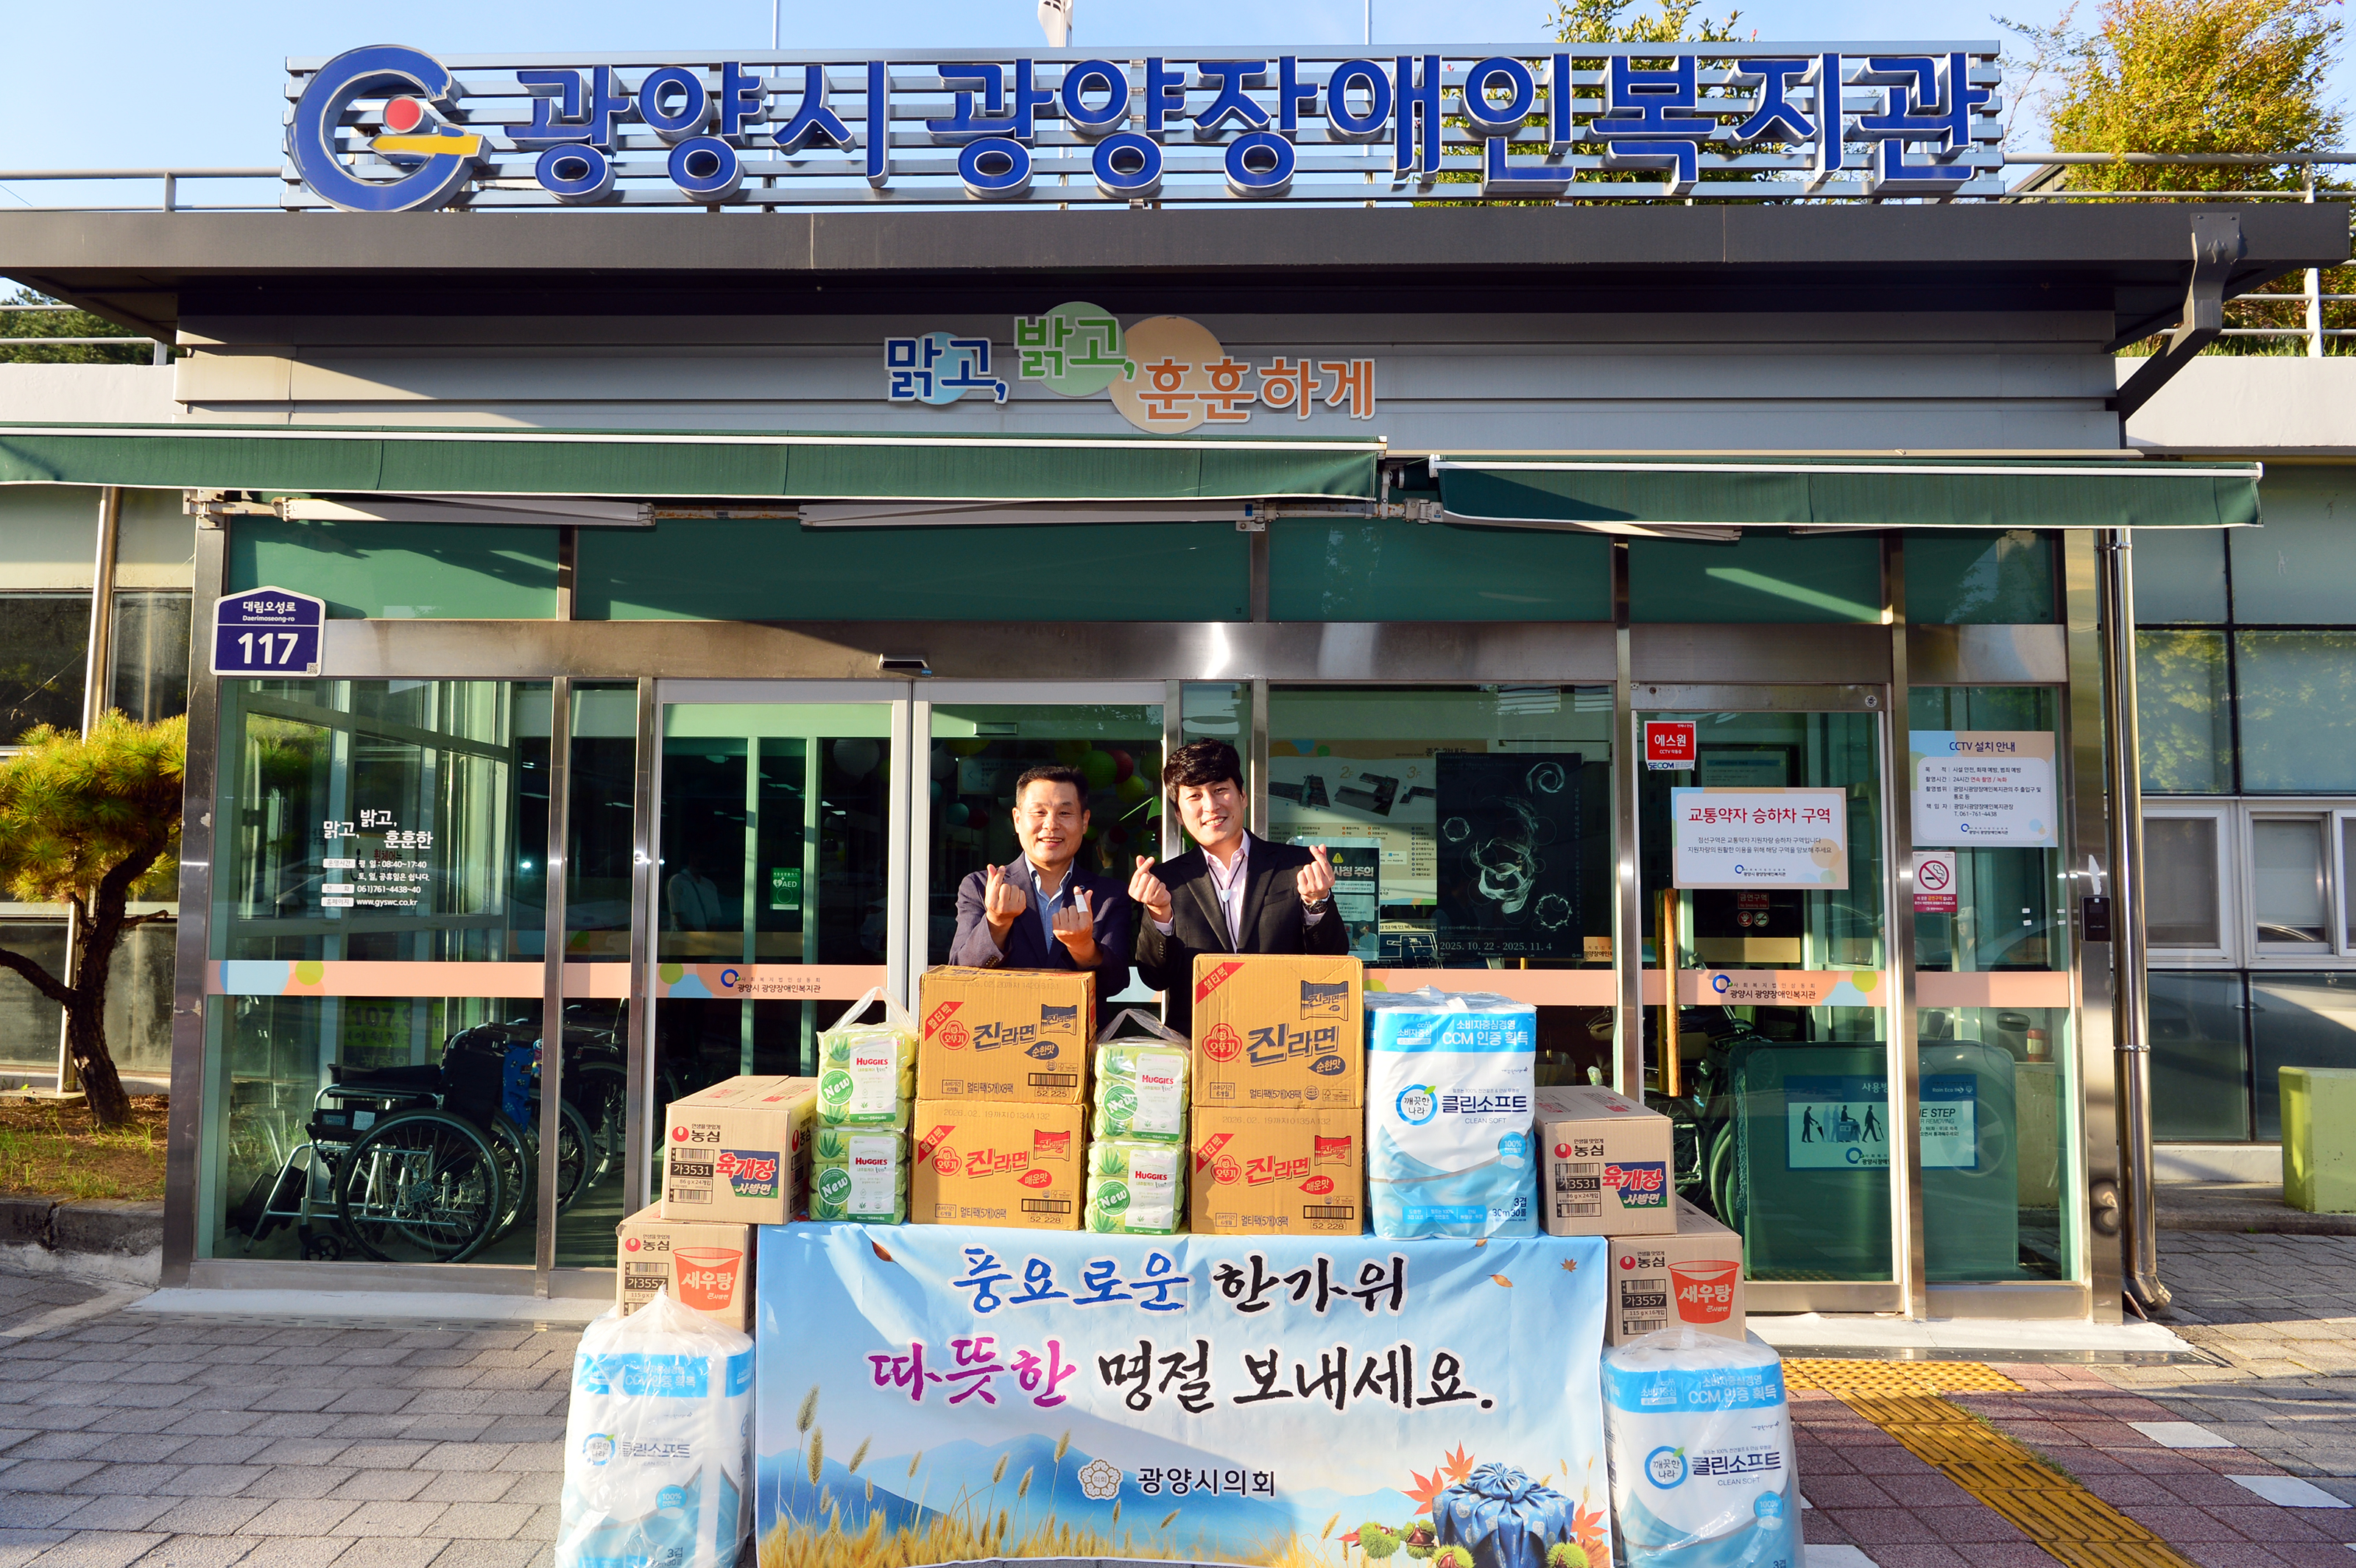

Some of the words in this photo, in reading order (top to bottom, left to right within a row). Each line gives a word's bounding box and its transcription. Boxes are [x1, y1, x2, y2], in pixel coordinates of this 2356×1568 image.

[504, 60, 890, 202] 광양시
[925, 52, 1992, 199] 광양장애인복지관
[1014, 314, 1137, 382] 밝고,
[885, 336, 1011, 404] 맑고,
[1137, 356, 1375, 423] 훈훈하게
[243, 601, 296, 614] 대림오성로
[238, 633, 298, 664] 117
[1654, 734, 1686, 746] 에스원
[1949, 741, 1972, 751] CCTV
[1975, 741, 1994, 752] 설치
[1997, 741, 2015, 752] 안내
[360, 809, 397, 827] 밝고,
[1688, 808, 1747, 824] 교통약자
[1752, 808, 1796, 824] 승하차
[1802, 808, 1830, 824] 구역
[324, 821, 360, 839] 맑고,
[384, 830, 434, 849] 훈훈한
[381, 861, 427, 869] 08:40~17:40
[1354, 866, 1374, 877] 주의
[356, 885, 421, 894] 061)761-4438~40
[356, 899, 418, 908] www.gyswc.co.kr
[1740, 894, 1767, 902] 금연구역
[1440, 942, 1464, 950] 2025.
[1468, 942, 1481, 950] 10.
[1484, 942, 1495, 950] 22
[1503, 942, 1528, 950] 2025.
[1531, 942, 1544, 950] 11.
[1546, 942, 1553, 950] 4
[1204, 966, 1228, 991] 멀티팩
[737, 984, 759, 993] 광양시
[761, 984, 821, 994] 광양장애인복지관
[1730, 990, 1753, 999] 광양시
[1754, 990, 1816, 1000] 광양장애인복지관
[927, 1004, 953, 1030] 멀티팩
[1456, 1020, 1516, 1030] 소비자중심경영
[945, 1034, 964, 1045] 오뚜기
[973, 1022, 1038, 1051] 진라면
[1442, 1032, 1473, 1045] CCM
[1477, 1031, 1501, 1045] 인증
[1505, 1031, 1528, 1046] 획득
[1032, 1044, 1054, 1057] 순한맛
[1210, 1042, 1235, 1053] 오뚜기
[1246, 1023, 1340, 1067] 진라면
[1316, 1060, 1341, 1073] 순한맛
[1142, 1075, 1174, 1084] HUGGIES
[823, 1078, 850, 1100] New
[1404, 1097, 1429, 1106] 깨끗한
[1442, 1095, 1528, 1114] 클린소프트
[1408, 1107, 1425, 1115] 나라
[1930, 1108, 1955, 1117] STEP
[691, 1130, 720, 1143] 농심
[921, 1126, 945, 1153] 멀티팩
[1574, 1145, 1604, 1157] 농심
[716, 1152, 775, 1180] 육개장
[856, 1157, 887, 1165] HUGGIES
[937, 1162, 957, 1170] 오뚜기
[965, 1149, 1031, 1178] 진라면
[674, 1164, 710, 1176] 가3531
[1135, 1170, 1167, 1181] HUGGIES
[1216, 1168, 1236, 1178] 오뚜기
[1245, 1156, 1311, 1187] 진라면
[1025, 1173, 1048, 1184] 매운맛
[1602, 1165, 1662, 1190] 육개장
[736, 1183, 772, 1195] 사발면
[822, 1176, 848, 1198] New
[1306, 1179, 1330, 1191] 매운맛
[1559, 1179, 1596, 1189] 가3531
[1099, 1189, 1127, 1209] New
[1514, 1197, 1527, 1207] 3겹
[1623, 1193, 1660, 1205] 사발면
[643, 1240, 669, 1251] 농심
[1637, 1257, 1665, 1268] 농심
[681, 1271, 734, 1290] 새우탕
[952, 1249, 1193, 1314] 풍요로운
[1212, 1254, 1407, 1313] 한가위
[1679, 1284, 1732, 1303] 새우탕
[1626, 1295, 1664, 1306] 가3557
[867, 1338, 1077, 1408] 따뜻한
[1099, 1338, 1215, 1413] 명절
[1234, 1345, 1493, 1410] 보내세요.
[1688, 1391, 1720, 1405] CCM
[1752, 1384, 1777, 1400] 획득
[1653, 1460, 1680, 1469] 깨끗한
[1692, 1452, 1781, 1476] 클린소프트
[1658, 1469, 1676, 1479] 나라
[1138, 1467, 1275, 1497] 광양시의회
[1718, 1478, 1741, 1486] CLEAN
[1743, 1477, 1760, 1485] SOFT
[667, 1548, 683, 1558] 3겹
